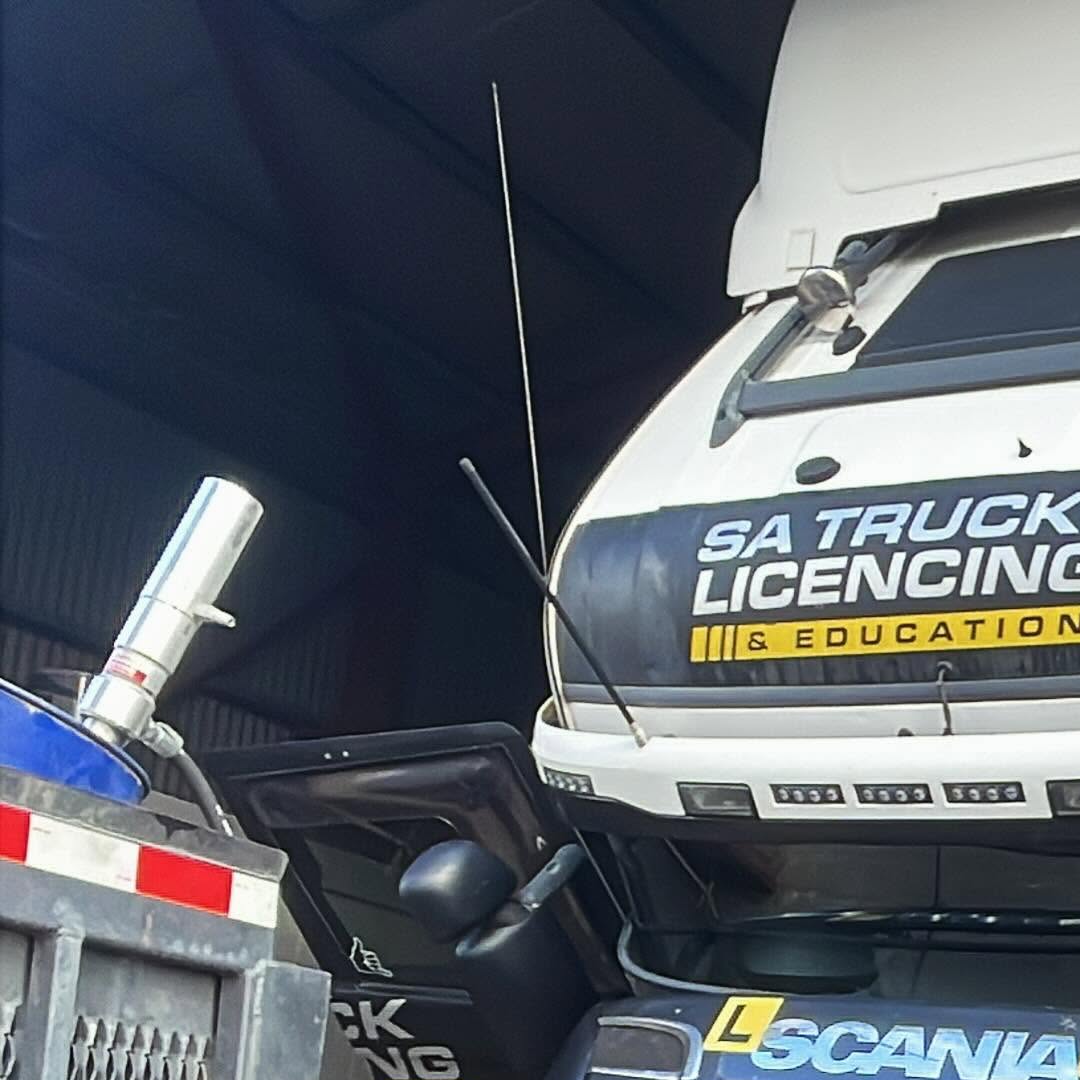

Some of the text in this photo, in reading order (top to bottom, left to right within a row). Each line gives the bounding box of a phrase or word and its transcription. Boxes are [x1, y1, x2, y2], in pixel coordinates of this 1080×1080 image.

[697, 513, 793, 562] SA
[747, 630, 768, 651] &
[717, 1003, 751, 1042] L
